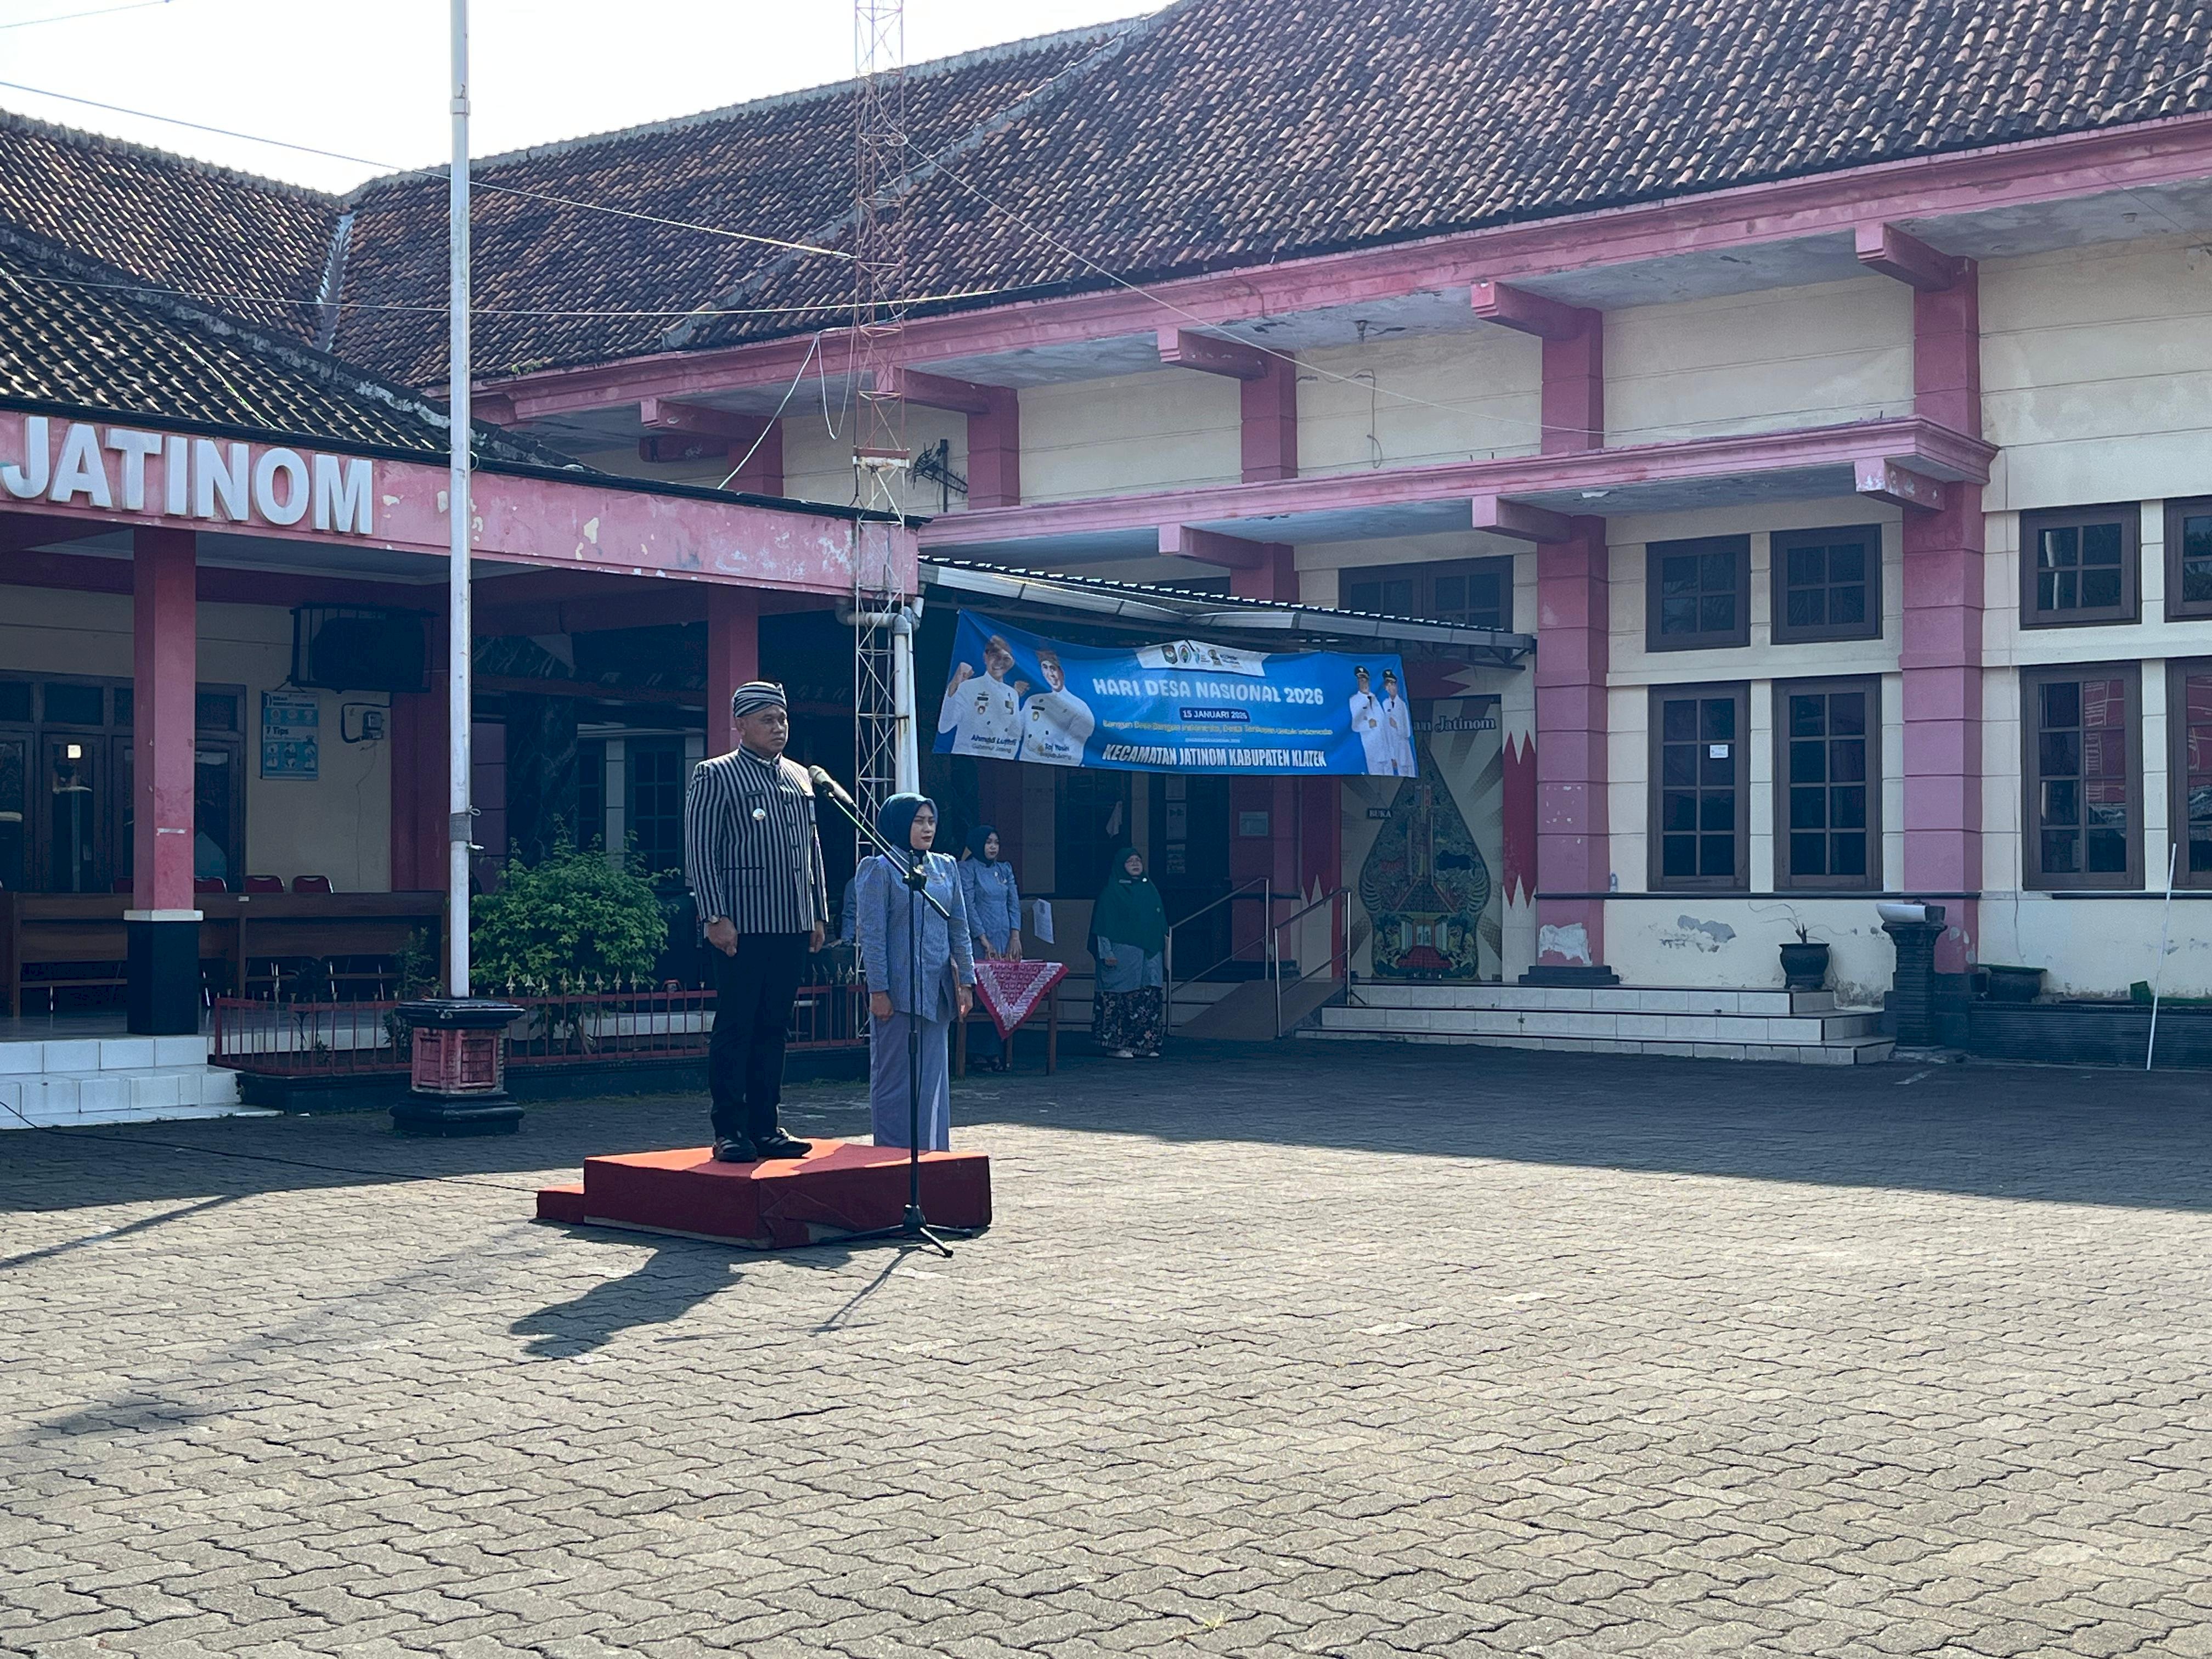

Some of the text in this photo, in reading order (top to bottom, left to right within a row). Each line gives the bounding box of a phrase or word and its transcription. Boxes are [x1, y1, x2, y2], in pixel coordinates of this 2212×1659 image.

[1, 416, 373, 535] JATINOM
[1092, 678, 1324, 705] HARI DESA NASIONAL 2026
[1183, 710, 1192, 718] 15
[1194, 710, 1229, 719] JANUARI
[273, 726, 289, 736] Tips
[1435, 715, 1496, 732] Jatinom
[1102, 743, 1327, 767] KECAMATAN JATINOM KABUPATEN KLATEN
[1369, 809, 1392, 818] BUKA
